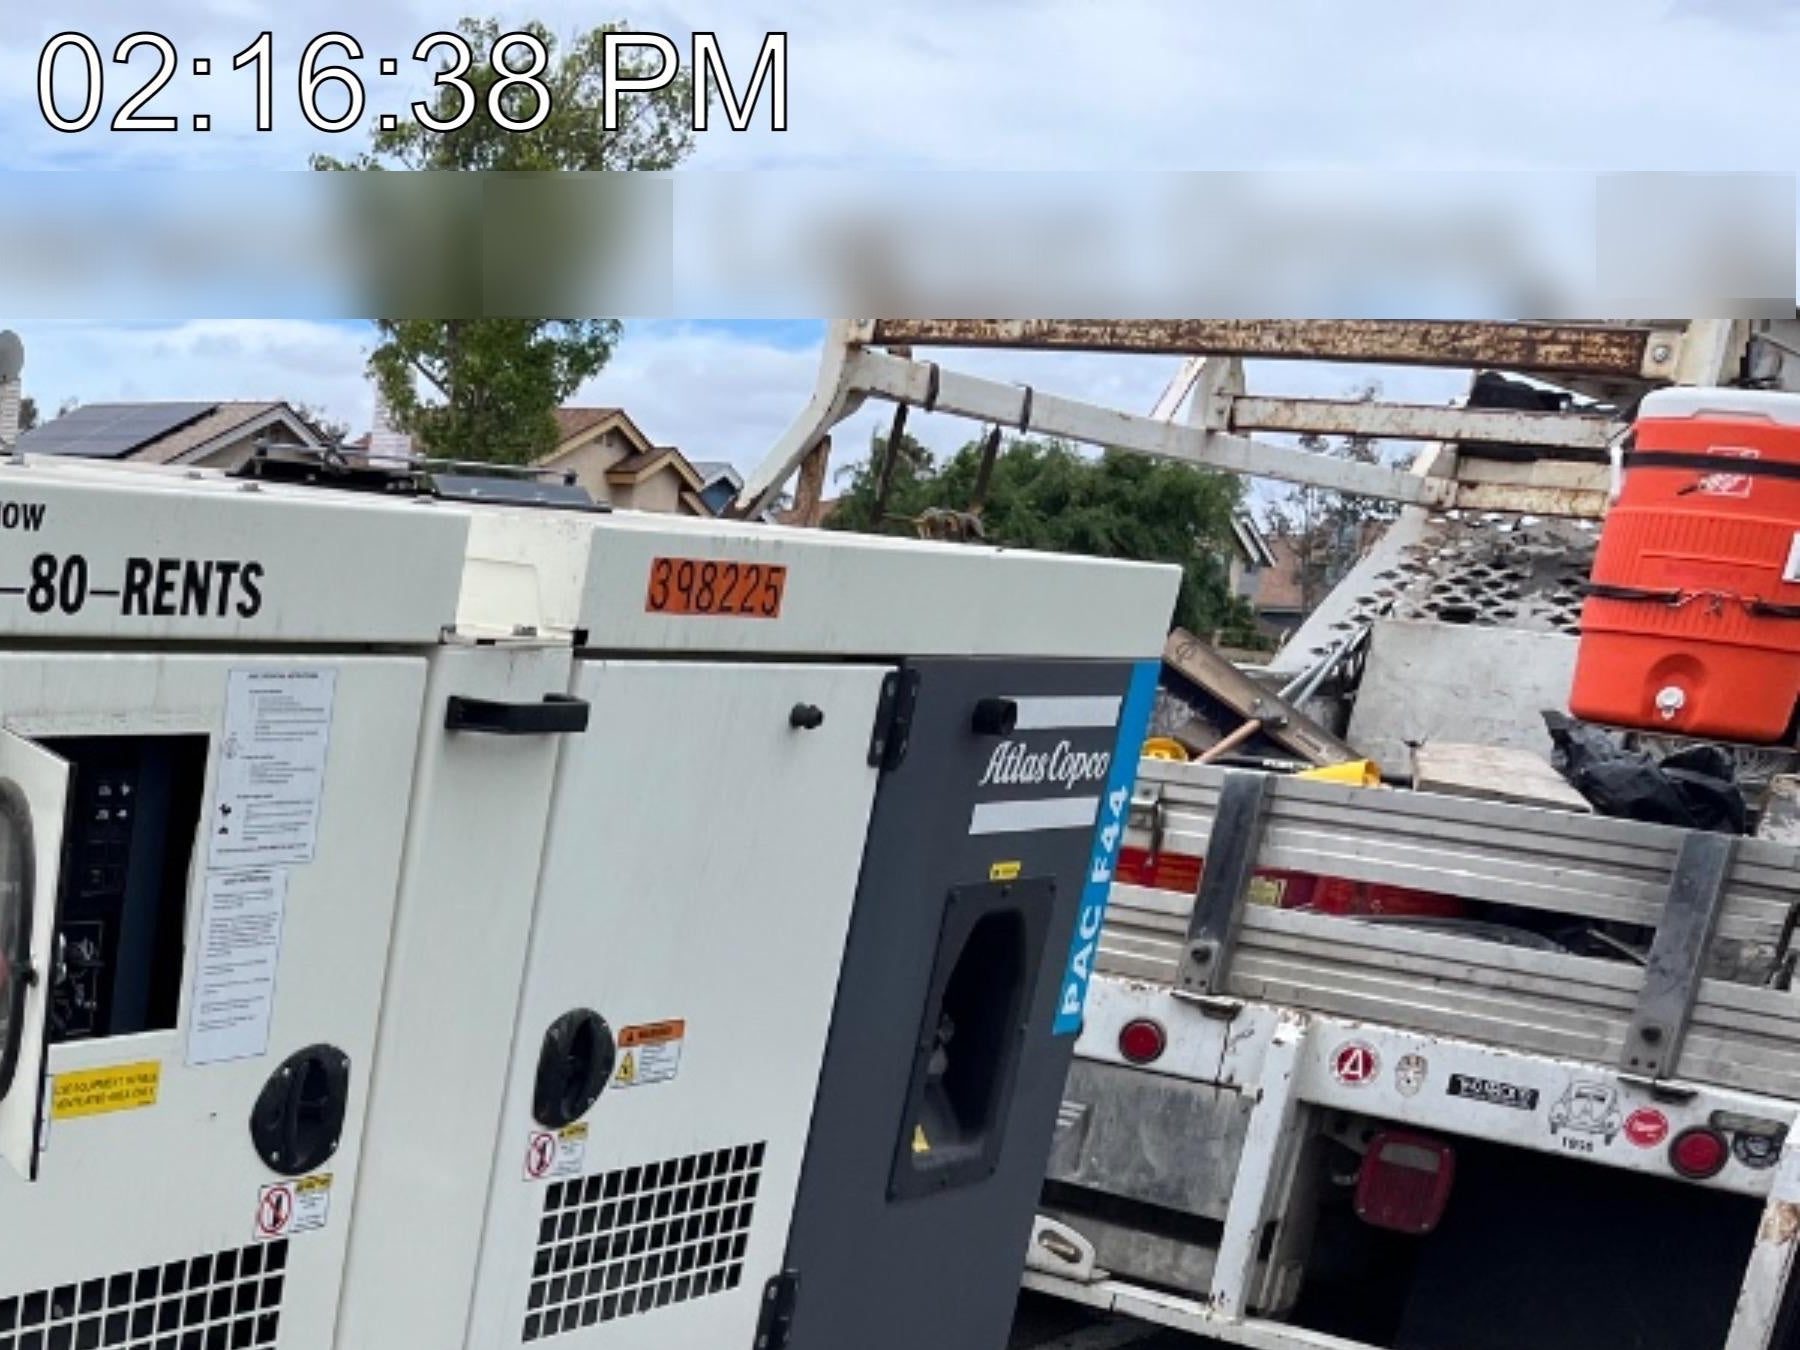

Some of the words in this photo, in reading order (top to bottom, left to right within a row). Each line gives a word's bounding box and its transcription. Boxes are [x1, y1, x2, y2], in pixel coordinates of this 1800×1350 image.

[650, 558, 782, 616] 398225
[978, 740, 1048, 787] Atlas
[1048, 739, 1112, 790] Copco
[1060, 904, 1102, 1015] PAC
[1091, 784, 1129, 883] F44
